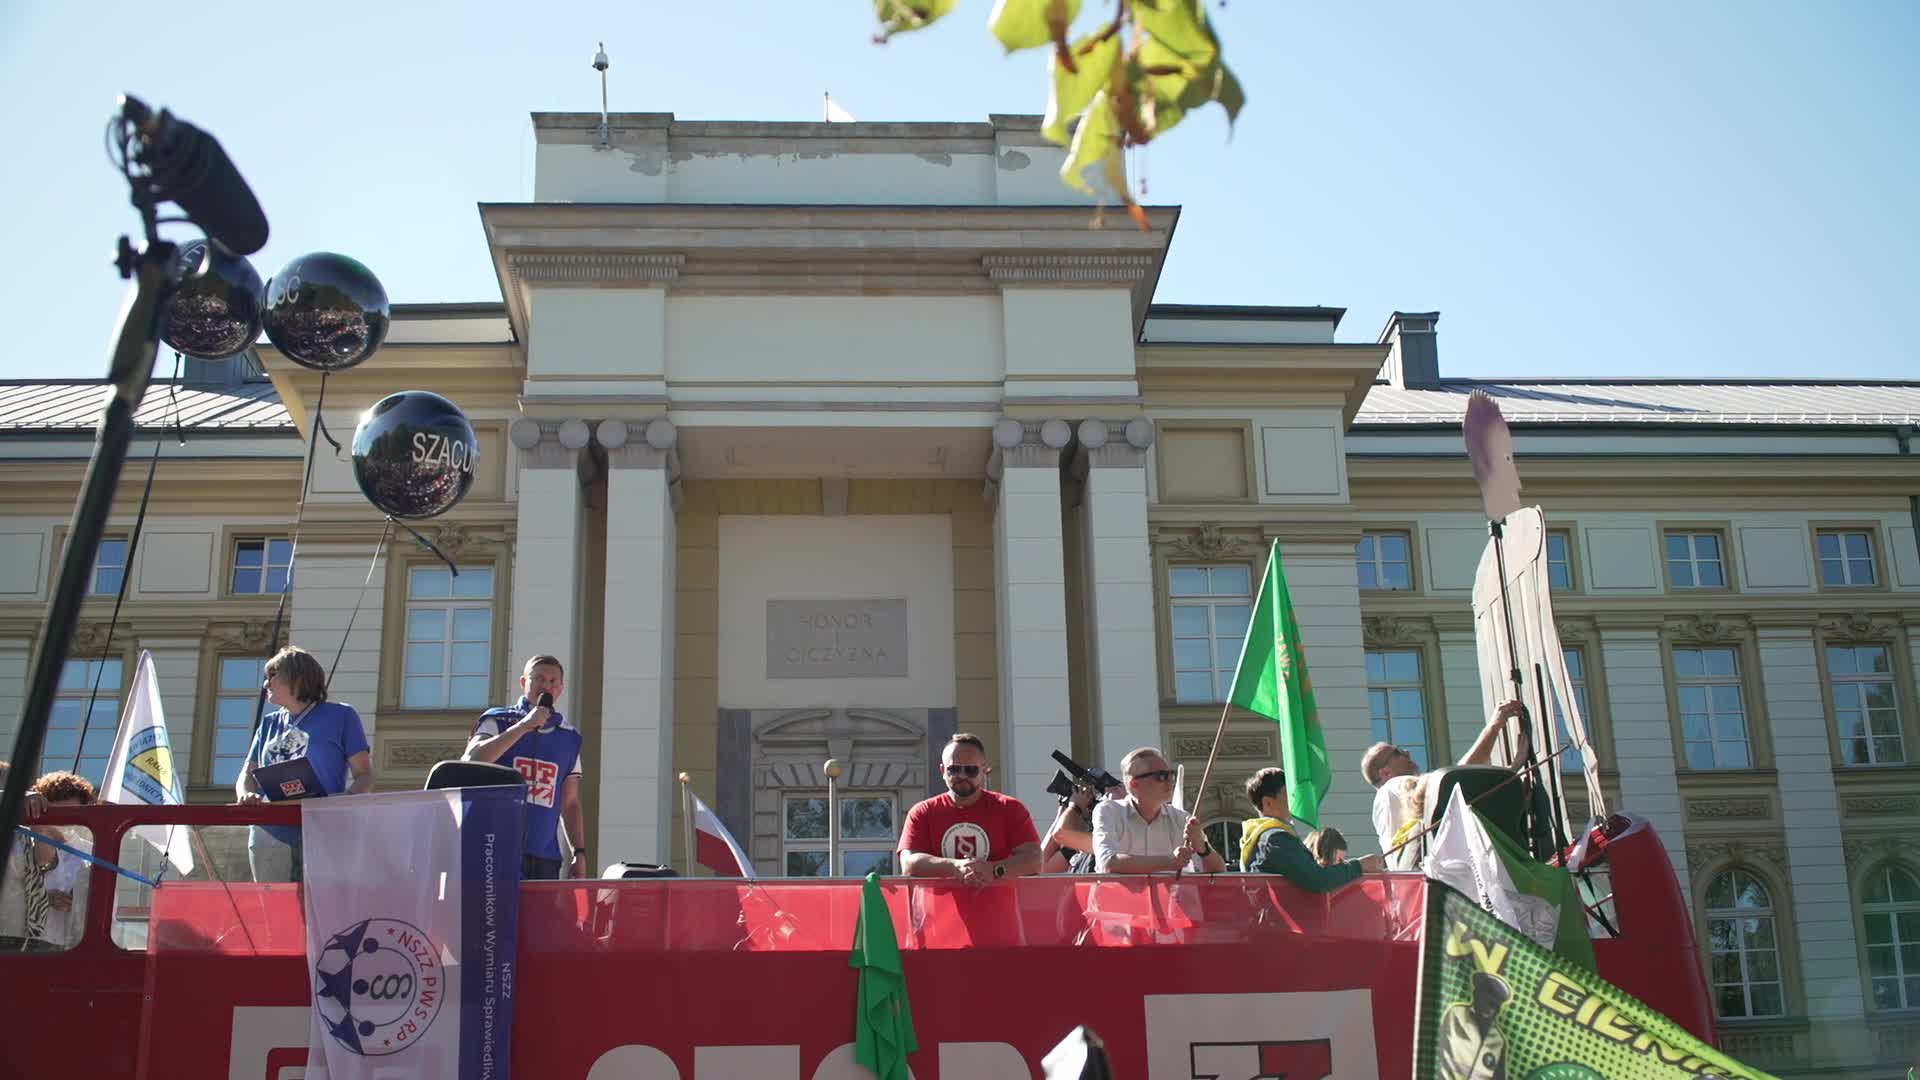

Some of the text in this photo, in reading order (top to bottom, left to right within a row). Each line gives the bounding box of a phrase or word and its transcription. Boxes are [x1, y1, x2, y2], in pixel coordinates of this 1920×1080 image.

[412, 432, 476, 474] SZACU
[799, 613, 874, 632] HONOR
[483, 929, 496, 993] Wymiaru
[501, 961, 511, 1000] NSZZ
[396, 931, 437, 1042] NSZZ PWS RP
